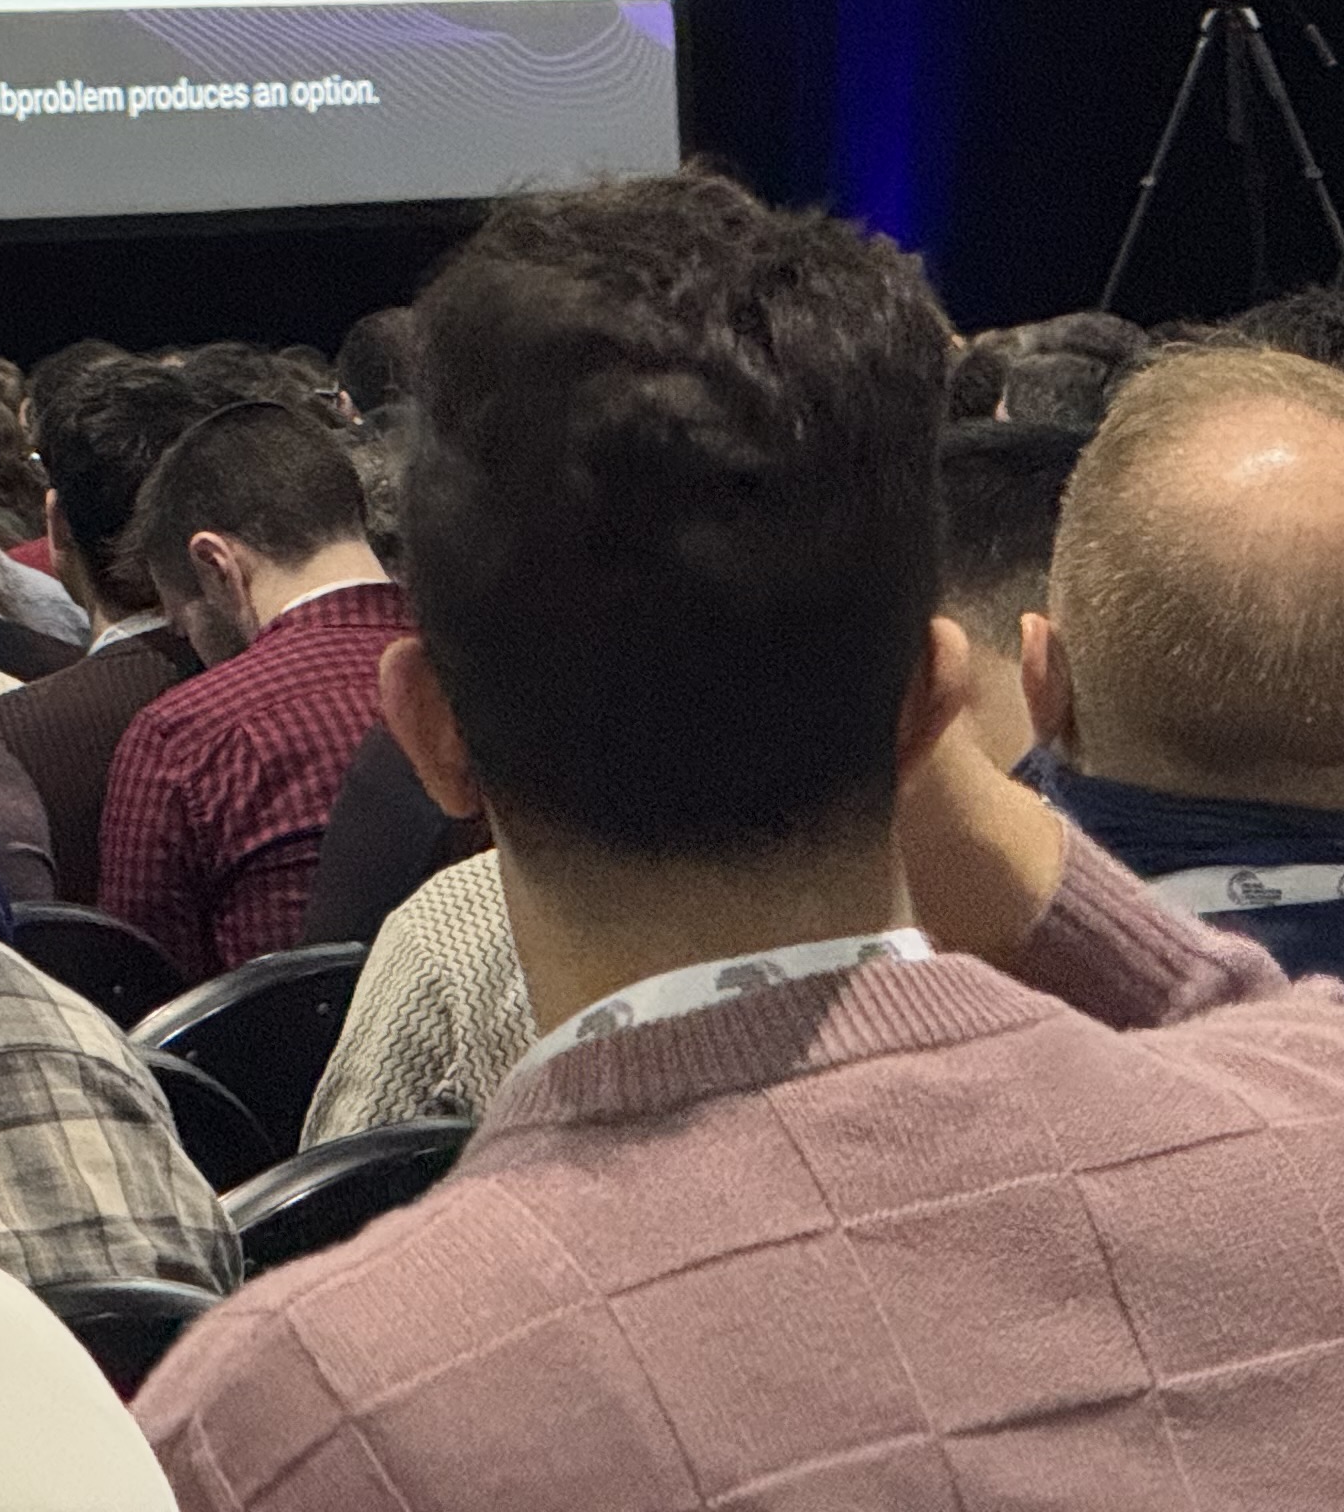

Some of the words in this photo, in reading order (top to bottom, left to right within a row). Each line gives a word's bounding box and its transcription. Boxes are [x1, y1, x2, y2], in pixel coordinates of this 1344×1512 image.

[128, 77, 248, 119] produces
[253, 81, 287, 109] an
[291, 75, 380, 114] option.
